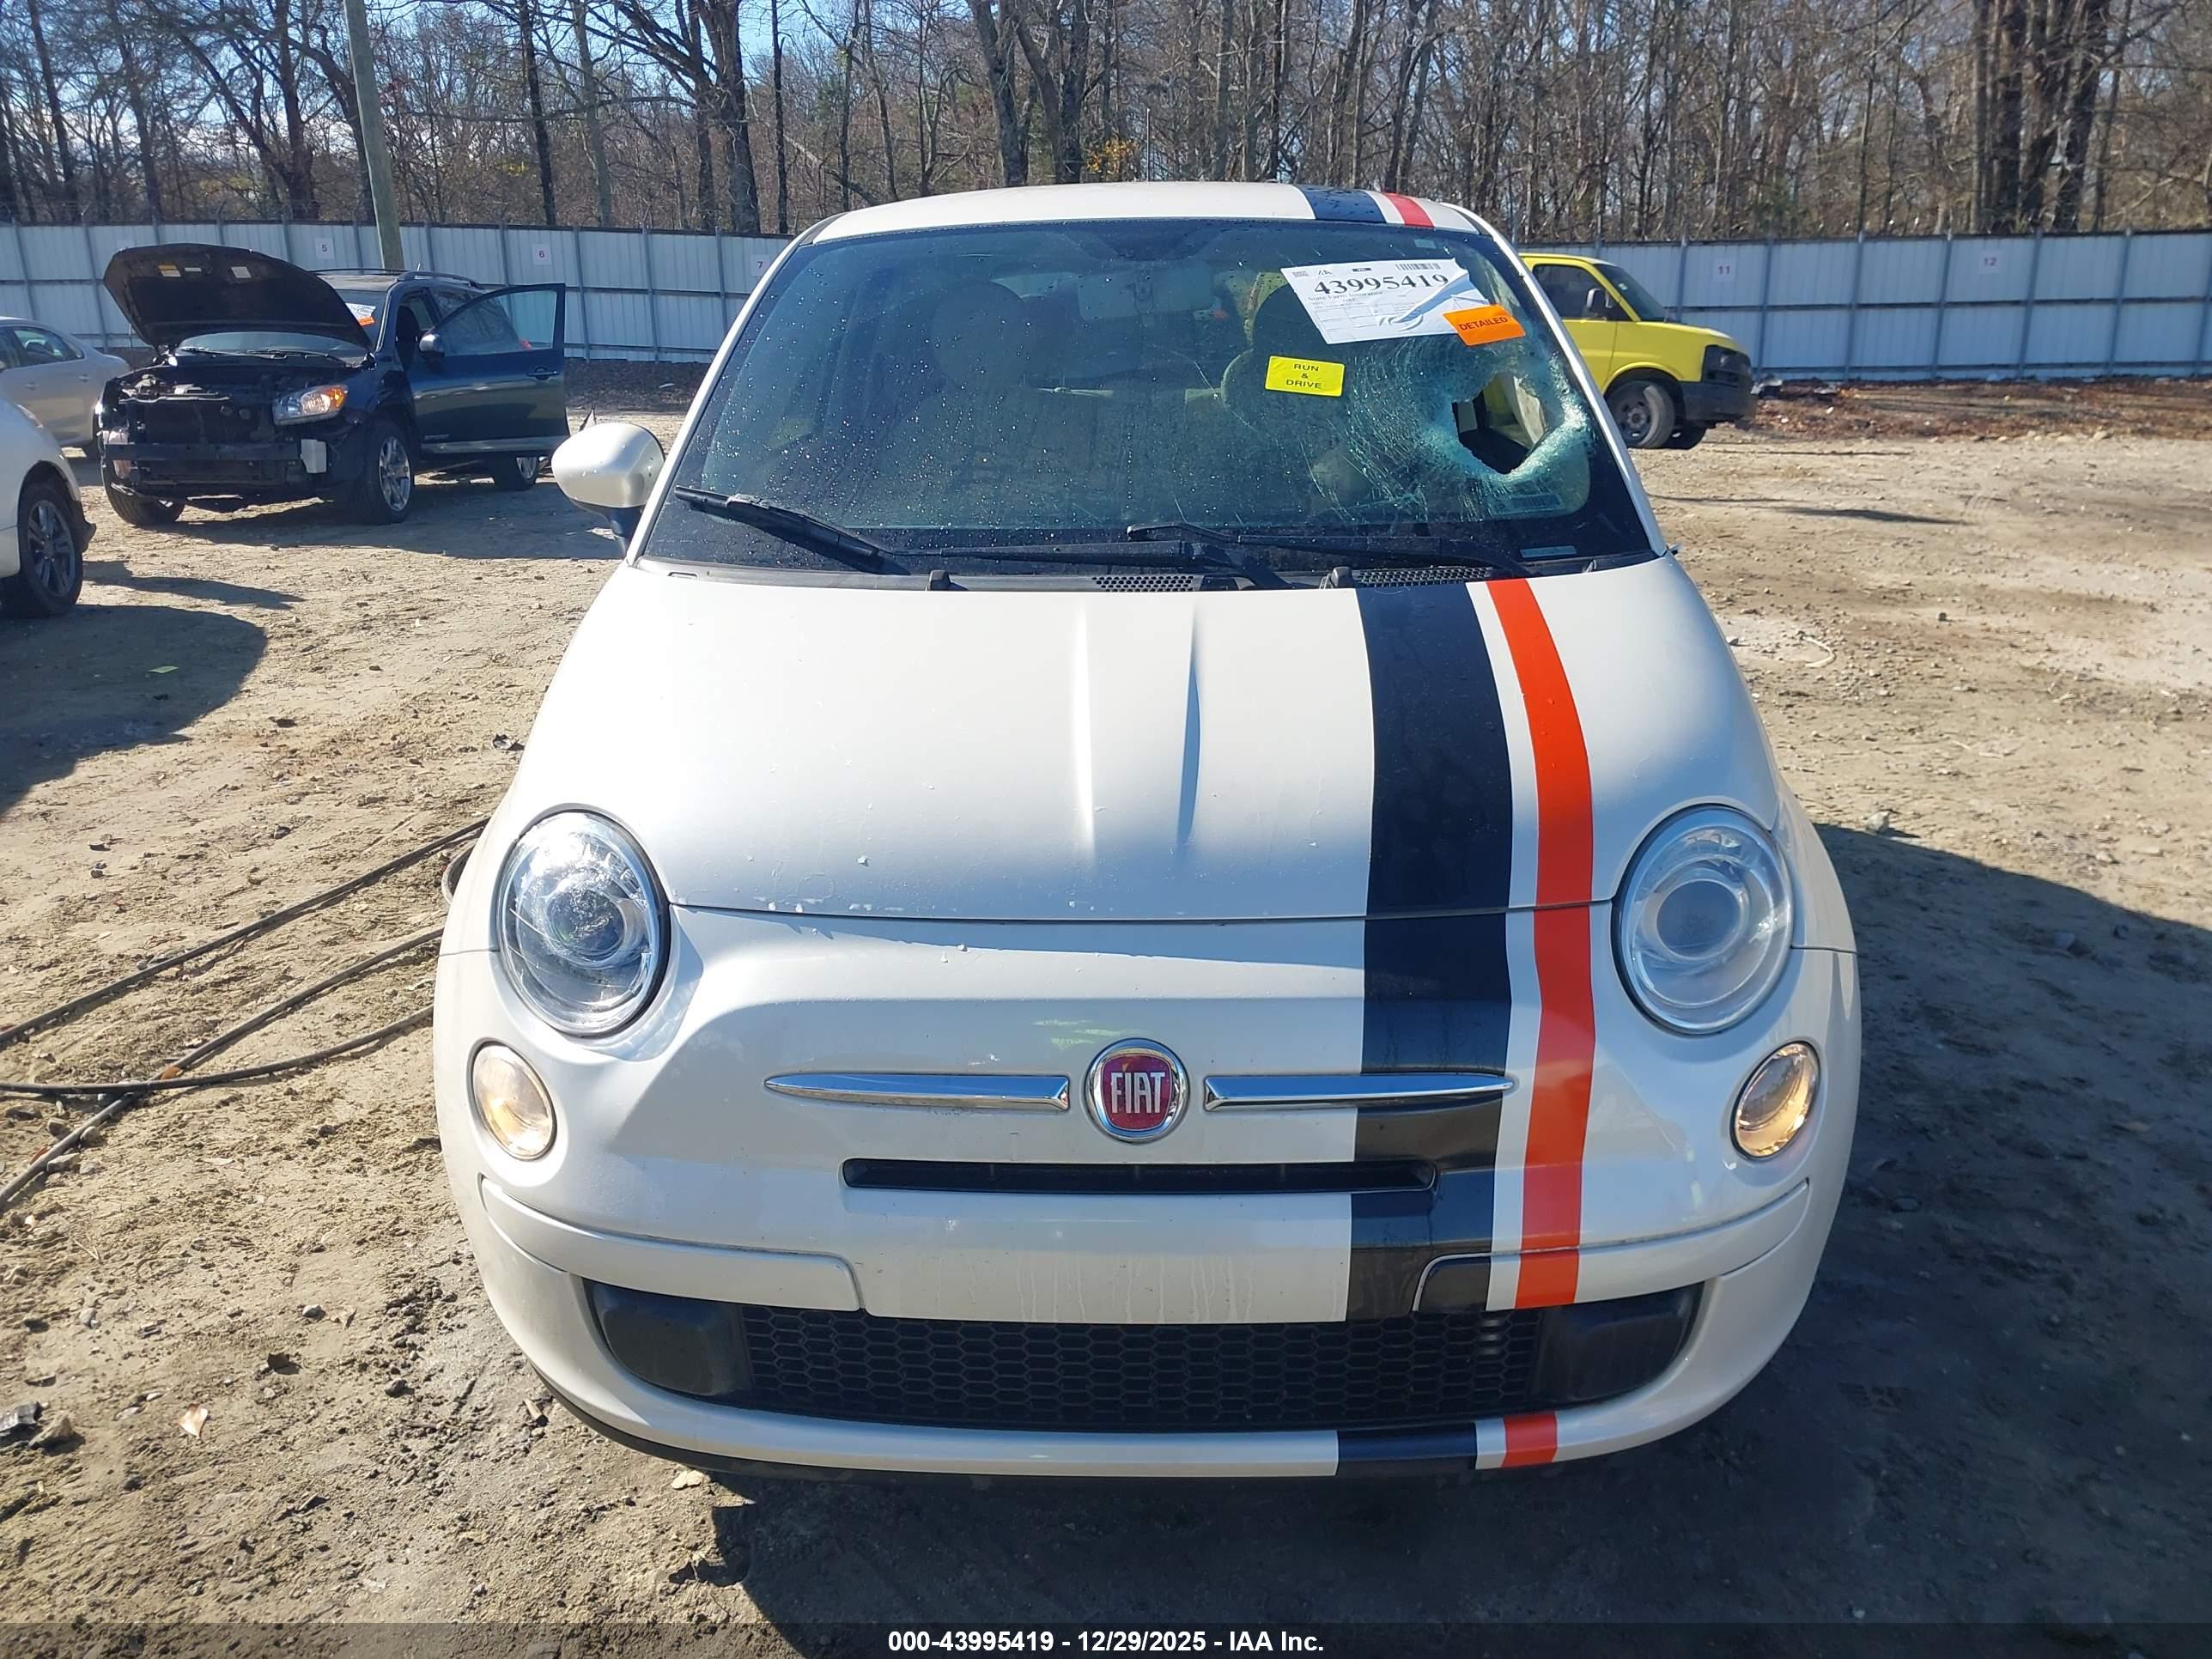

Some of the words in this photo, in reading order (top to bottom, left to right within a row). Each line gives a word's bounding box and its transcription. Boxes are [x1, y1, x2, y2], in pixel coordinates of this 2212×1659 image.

[321, 244, 328, 252] 5
[538, 250, 545, 258] 6
[757, 260, 763, 269] 7
[1718, 265, 1731, 276] 11
[1314, 274, 1449, 295] 43995419
[1458, 316, 1509, 331] DETAILED
[1293, 363, 1320, 372] RUN
[1285, 379, 1322, 389] DRIVE
[1110, 1072, 1165, 1114] FIAT
